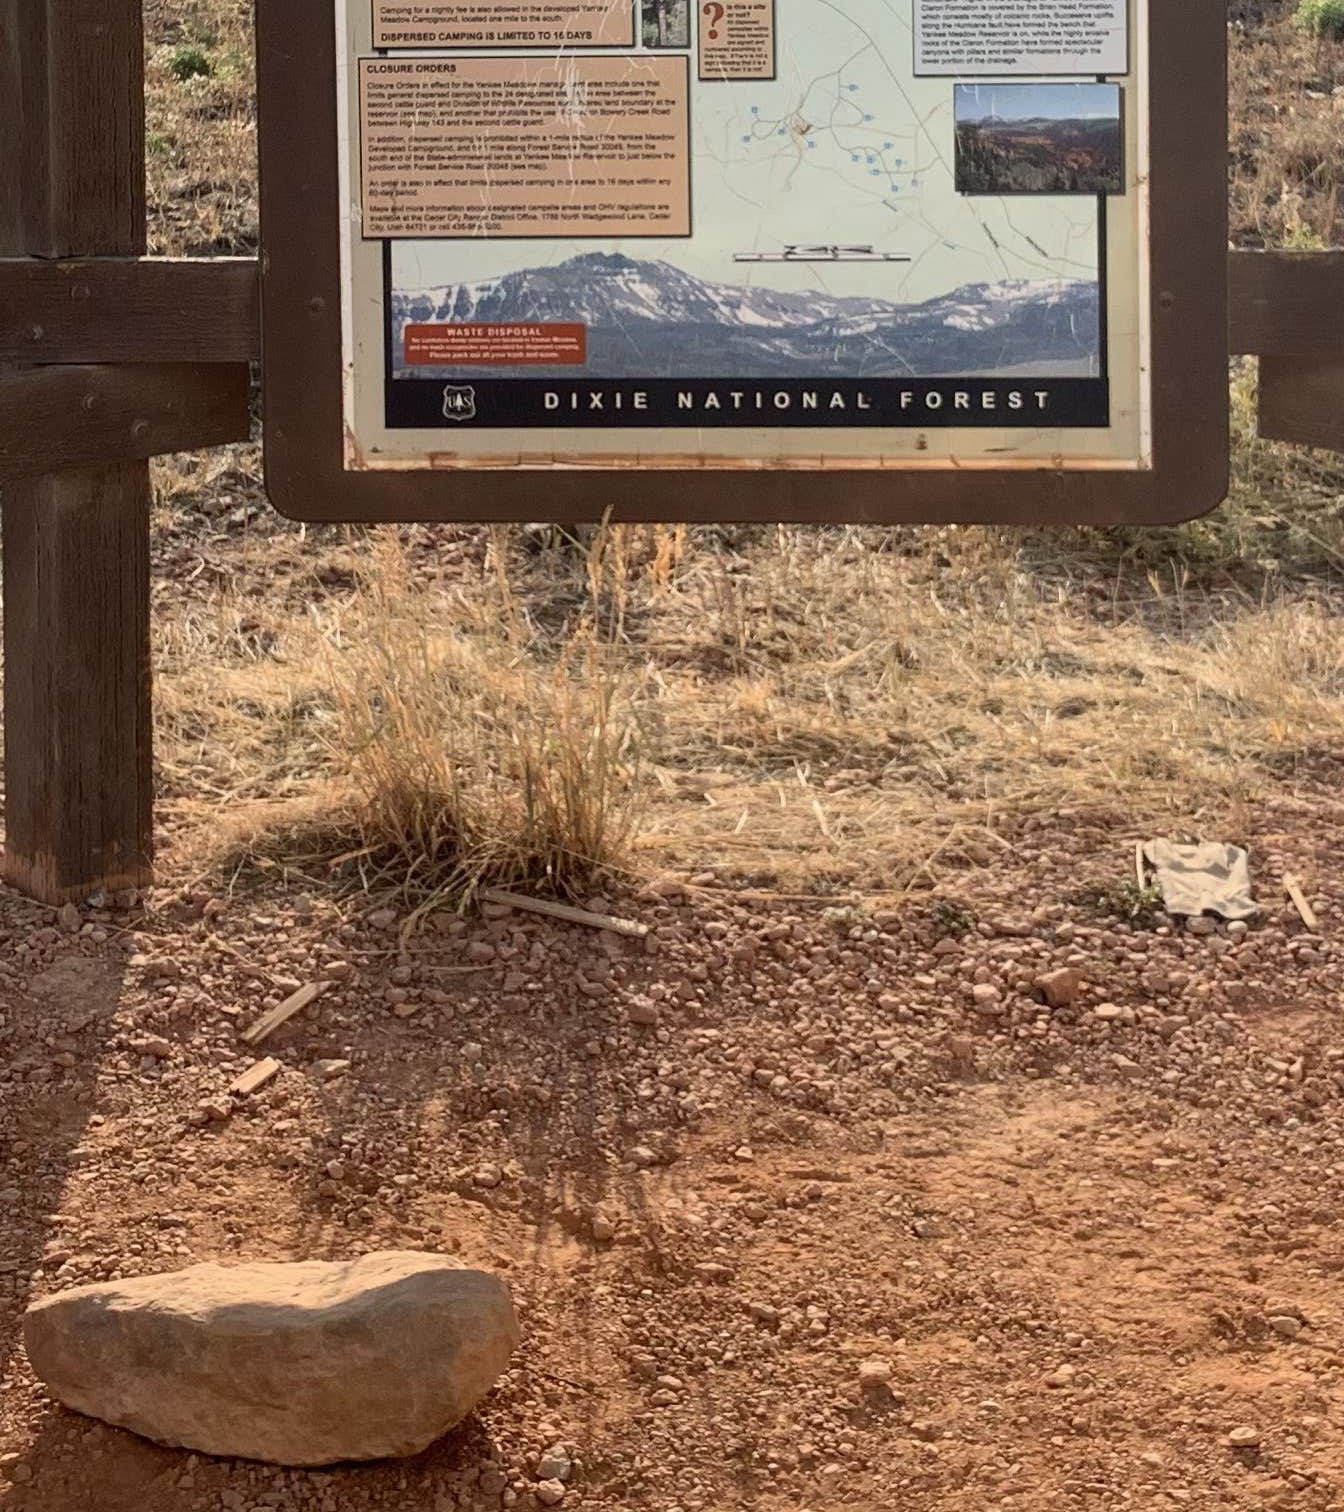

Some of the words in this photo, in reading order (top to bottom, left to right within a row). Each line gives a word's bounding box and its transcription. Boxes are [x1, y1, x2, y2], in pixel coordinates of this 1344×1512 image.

[380, 32, 436, 42] DISPERSED
[438, 31, 484, 41] CAMPING
[485, 32, 495, 41] IS
[497, 31, 536, 41] LIMITED
[537, 31, 552, 40] TO
[566, 31, 593, 40] DAYS
[367, 64, 414, 74] CLOSURE
[415, 63, 457, 73] ORDERS
[447, 327, 483, 337] WASTE
[488, 327, 542, 336] DISPOSAL
[544, 391, 648, 409] DIXIE
[678, 391, 871, 409] NATIONAL
[900, 391, 1050, 409] FOREST
